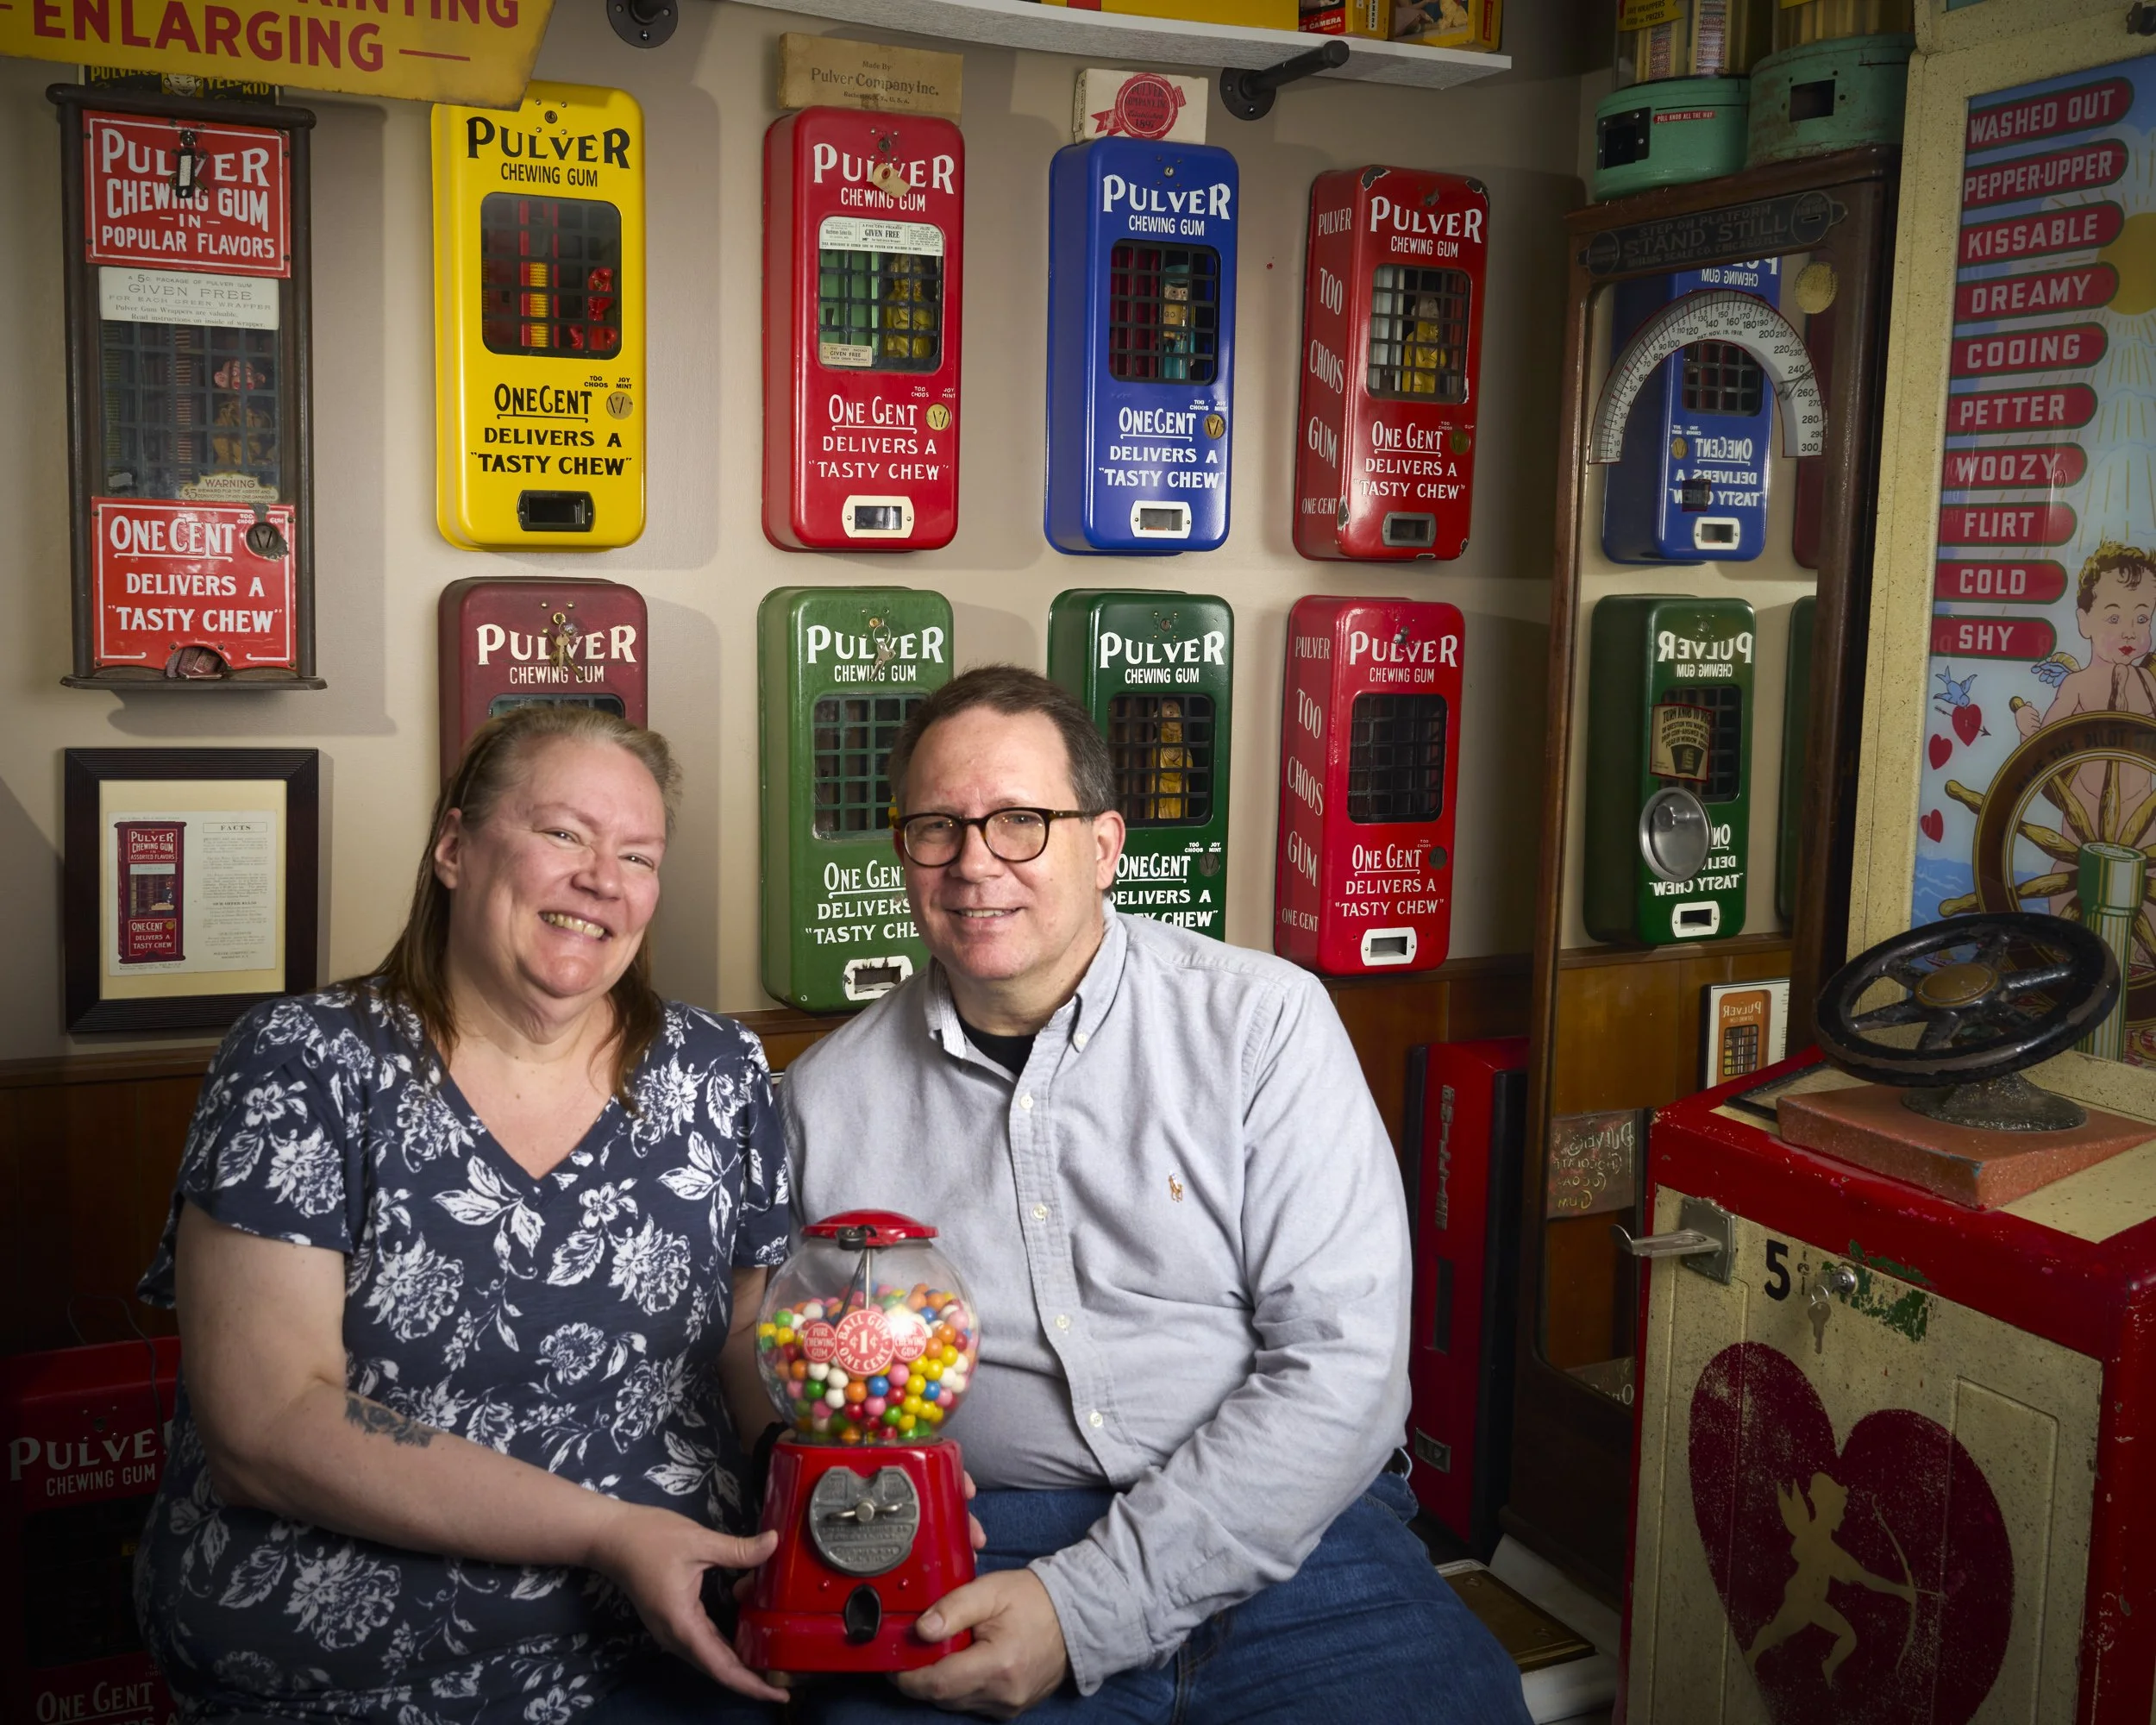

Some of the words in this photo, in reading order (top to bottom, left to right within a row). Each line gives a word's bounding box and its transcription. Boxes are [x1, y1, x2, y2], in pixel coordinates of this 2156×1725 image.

[1309, 16, 1342, 30] CAMERA
[33, 0, 384, 72] ENLARGING
[812, 67, 854, 85] Pulver
[856, 72, 915, 94] Company
[917, 80, 939, 97] Inc.
[1970, 101, 2058, 144] WASHED
[2067, 89, 2115, 122] OUT
[466, 116, 631, 169] PULVER
[501, 162, 561, 185] CHEWING
[567, 167, 599, 187] GUM
[841, 187, 893, 210] CHEWING
[899, 192, 925, 212] GUM
[1102, 174, 1231, 220] PULVER
[179, 213, 201, 229] IN
[217, 188, 269, 233] GUM
[1318, 207, 1351, 236] PULVER
[1369, 196, 1482, 243] PULVER
[1129, 215, 1175, 234] CHEWING
[1180, 219, 1205, 236] GUM
[1624, 228, 1706, 257] STAND
[1717, 216, 1789, 242] STILL
[1967, 214, 2098, 260] KISSABLE
[102, 225, 187, 252] POPULAR
[197, 233, 275, 258] FLAVORS
[1391, 235, 1432, 255] CHEWING
[1437, 242, 1458, 258] GUM
[128, 284, 188, 298] GIVEN
[200, 288, 253, 300] FREE
[1319, 267, 1343, 316] TOO
[1971, 274, 2090, 314] DREAMY
[218, 302, 272, 310] WRAPPER
[1706, 319, 1719, 328] 140
[1727, 317, 1739, 326] 160
[1668, 340, 1680, 348] 100
[1309, 340, 1344, 394] CHOOS
[829, 394, 864, 425] ONE
[872, 396, 918, 426] CENT
[1959, 394, 2065, 426] PETTER
[484, 428, 595, 447] DELIVERS
[606, 432, 622, 448] A
[823, 436, 918, 455] DELIVERS
[924, 440, 937, 455] A
[1308, 417, 1337, 469] GUM
[1372, 421, 1402, 449] ONE
[1406, 423, 1443, 450] CENT
[1801, 443, 1819, 452] 300
[1110, 445, 1197, 463] DELIVERS
[1206, 450, 1218, 464] A
[1365, 458, 1443, 476] DELIVERS
[1447, 462, 1457, 476] A
[1956, 453, 2062, 482] WOOZY
[205, 480, 255, 488] WARNING
[110, 516, 166, 554] ONE
[169, 518, 236, 555] CENT
[1964, 512, 2034, 537] FLIRT
[126, 573, 236, 597] DELIVERS
[248, 577, 265, 597] A
[1959, 568, 2027, 595] COLD
[1099, 631, 1225, 668] PULVER
[1295, 636, 1331, 660] PULVER
[1349, 630, 1458, 668] PULVER
[1959, 624, 2015, 651] SHY
[510, 666, 568, 684] CHEWING
[891, 665, 917, 681] GUM
[1125, 668, 1170, 684] CHEWING
[1175, 668, 1200, 683] GUM
[1369, 668, 1410, 682] CHEWING
[1414, 668, 1434, 682] GUM
[1297, 688, 1322, 739] TOO
[1288, 756, 1323, 816] CHOOS
[131, 831, 174, 843] PULVER
[132, 843, 158, 854] CHEWING
[160, 843, 173, 854] GUM
[1288, 831, 1318, 888] GUM
[1352, 844, 1382, 872] ONE
[1386, 844, 1422, 869] CENT
[824, 862, 862, 892] ONE
[1345, 879, 1422, 894] DELIVERS
[1426, 878, 1436, 892] A
[818, 898, 911, 919] DELIVERS
[1199, 890, 1212, 904] A
[812, 1327, 828, 1337] PURE
[838, 1314, 863, 1340] BALL
[868, 1314, 892, 1340] GUM
[805, 1337, 835, 1347] CHEWING
[812, 1348, 828, 1357] GUM
[839, 1347, 859, 1370] ONE
[863, 1346, 891, 1371] CENT
[46, 1469, 114, 1497] CHEWING
[122, 1463, 155, 1484] GUM
[36, 1690, 86, 1724] ONE
[92, 1680, 154, 1715] CENT
